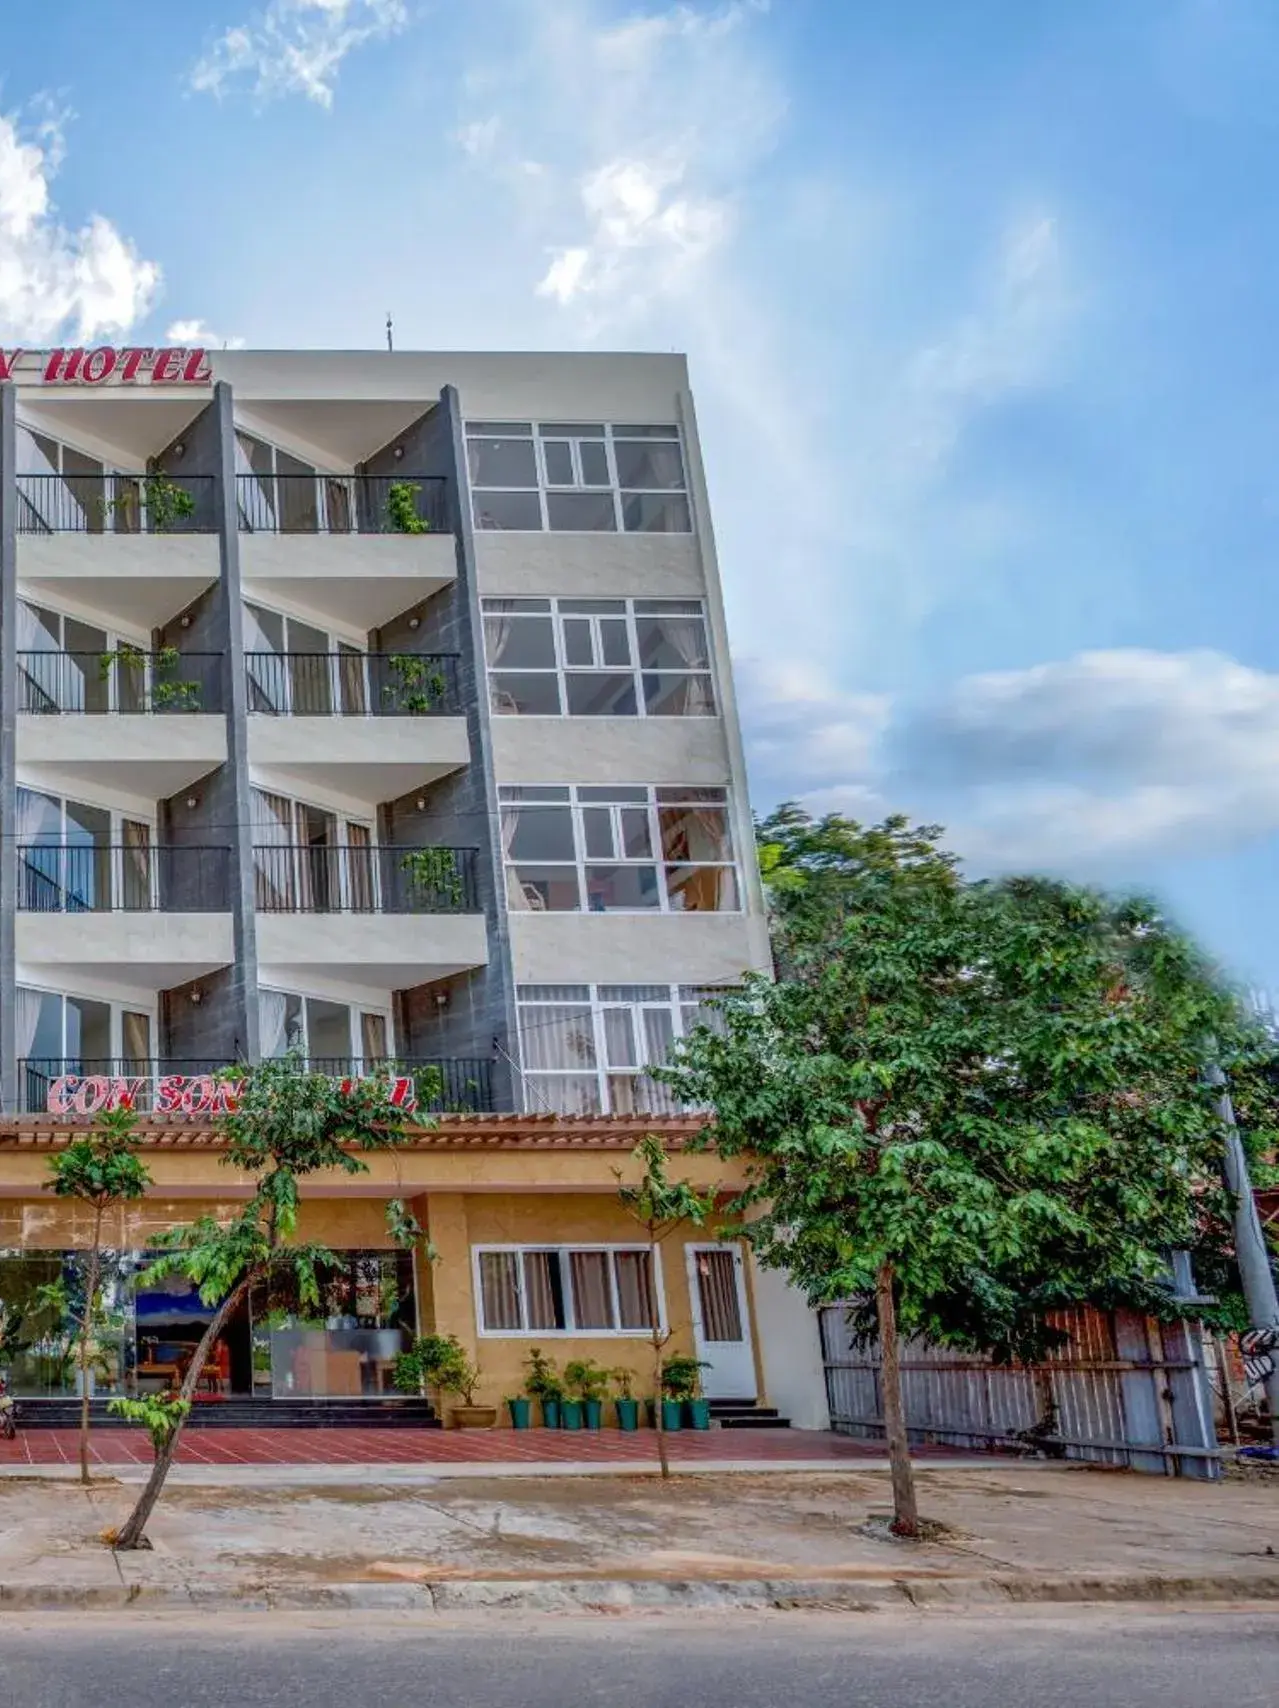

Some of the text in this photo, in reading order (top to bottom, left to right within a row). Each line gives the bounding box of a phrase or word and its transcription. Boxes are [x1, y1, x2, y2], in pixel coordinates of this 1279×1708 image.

[43, 345, 213, 383] HOTEL
[46, 1075, 145, 1114] CON
[154, 1075, 249, 1115] SON
